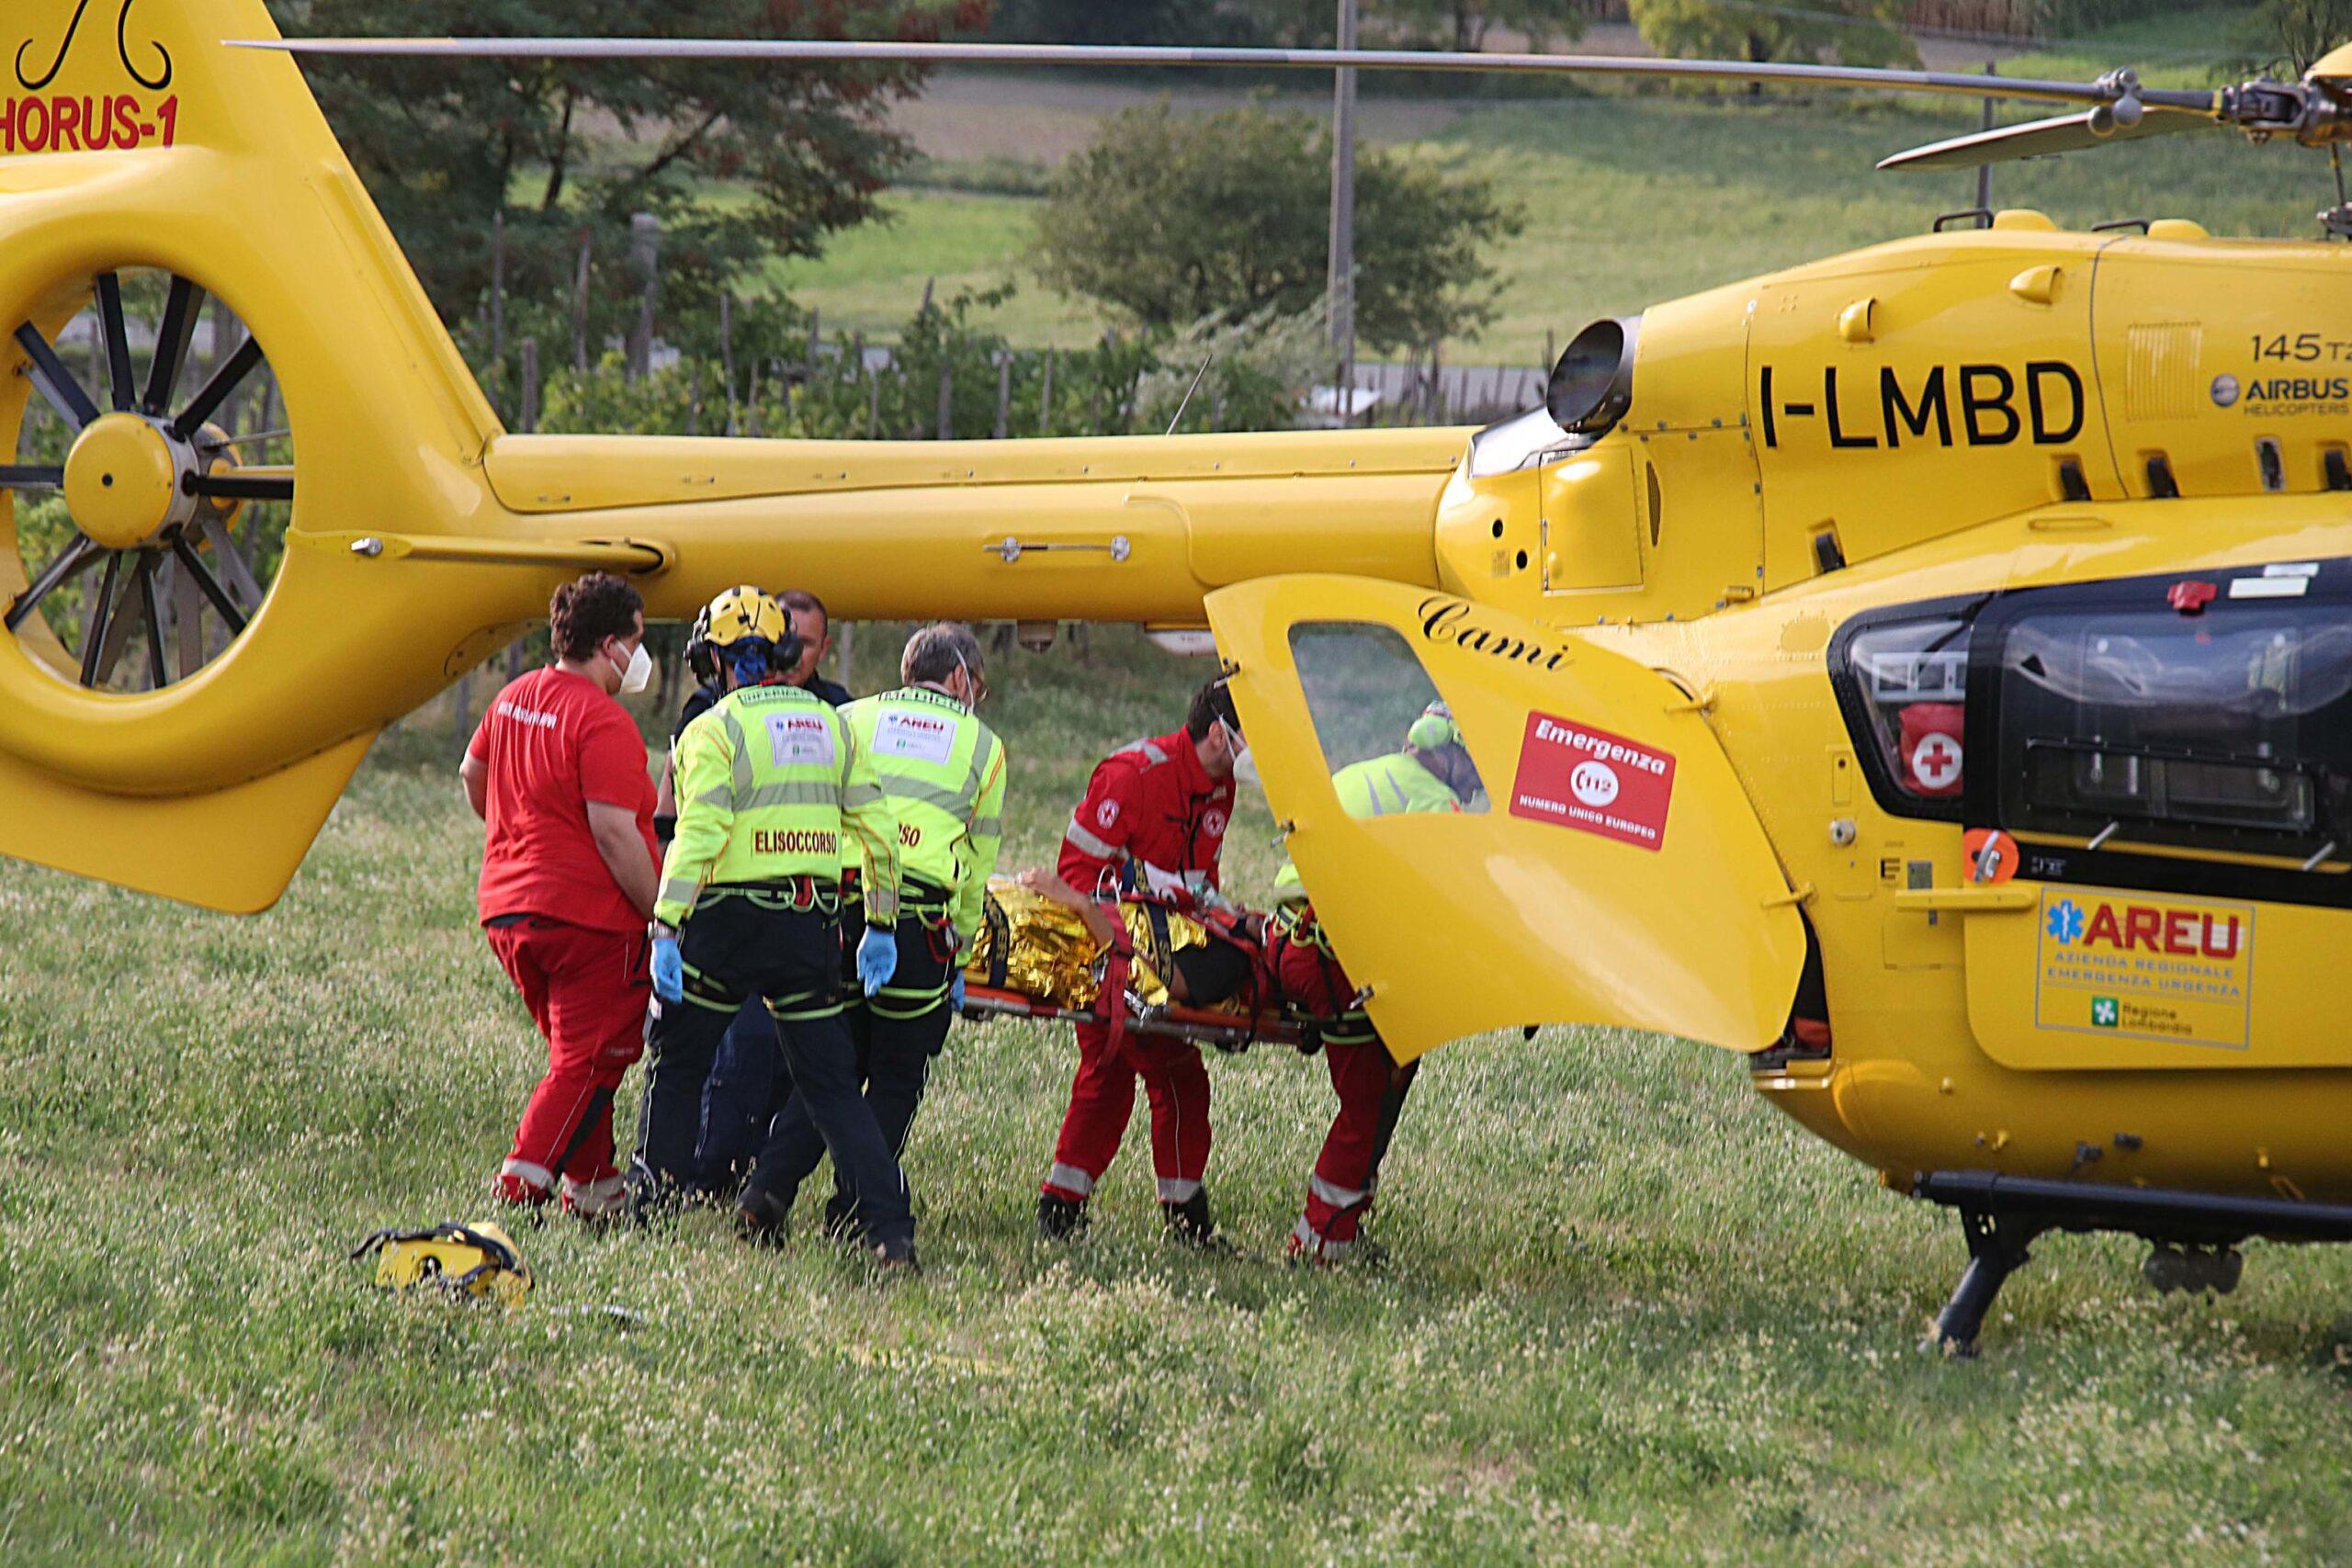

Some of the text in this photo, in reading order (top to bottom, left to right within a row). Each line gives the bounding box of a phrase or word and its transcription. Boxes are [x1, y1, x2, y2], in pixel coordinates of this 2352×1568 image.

[2246, 378, 2349, 400] AIRBUS
[1761, 361, 2084, 448] I-LMBD
[2245, 402, 2350, 416] HELICOPTERS
[1418, 596, 1575, 671] Cami
[900, 716, 944, 731] AREU
[1535, 718, 1667, 775] Emergenza
[1519, 795, 1656, 840] NUMERO UNICO EUROPEO
[754, 829, 837, 855] ELISOCCORSO
[2083, 902, 2239, 960] AREU
[2054, 952, 2233, 978] AZIENDA REGIONALE
[2048, 967, 2240, 996] EMERGENZA URGENZA
[2122, 1002, 2177, 1020] Regione
[2122, 1017, 2192, 1035] Lombardia
